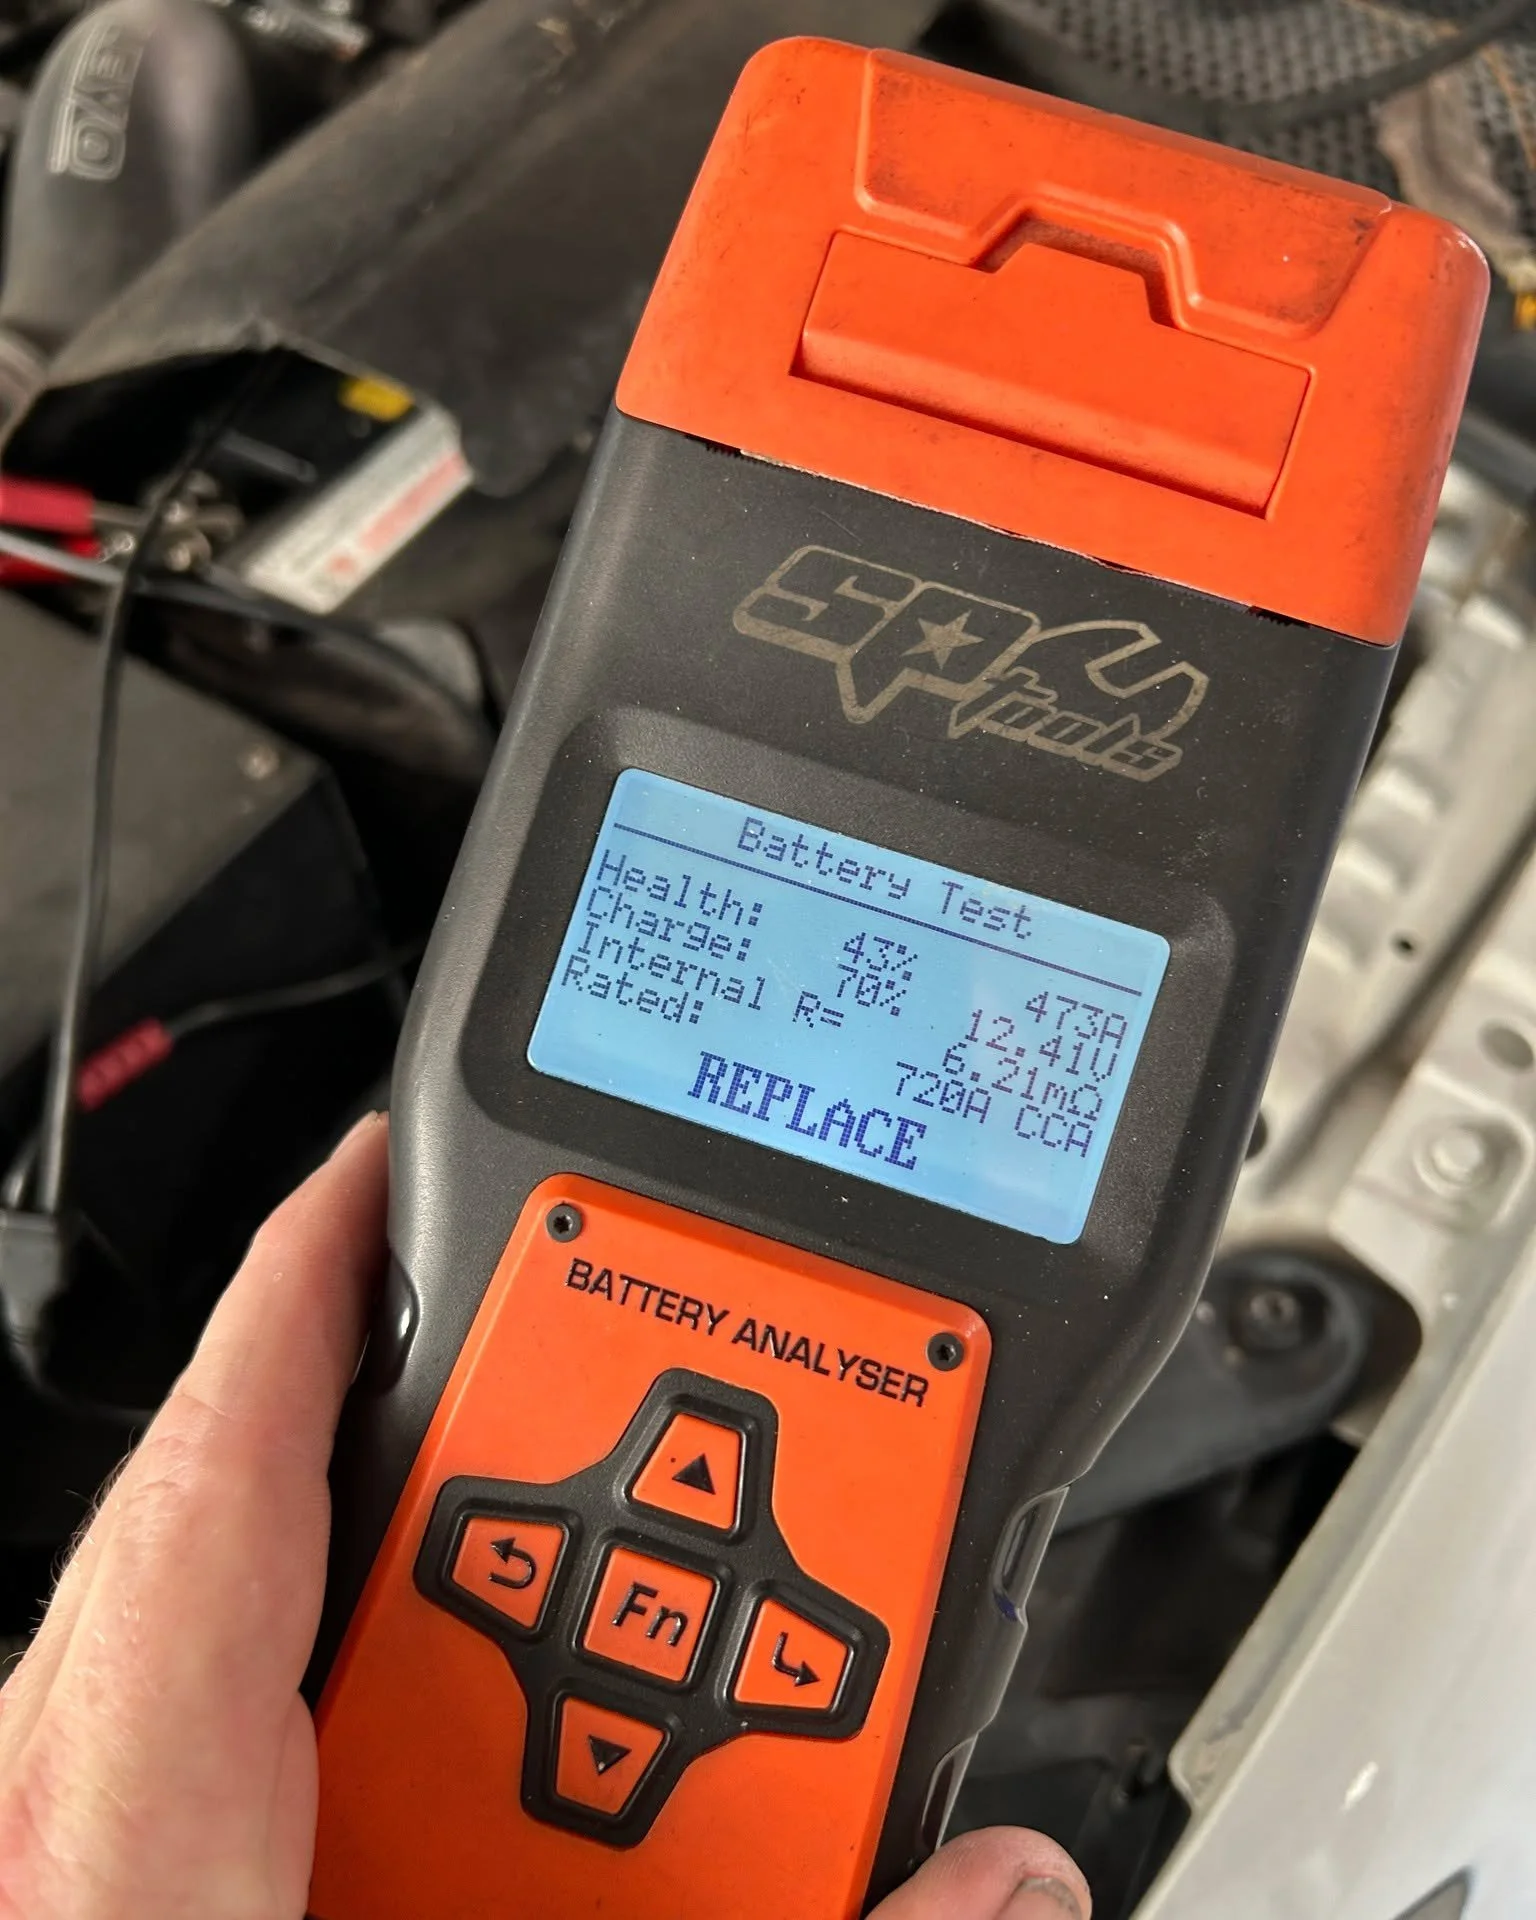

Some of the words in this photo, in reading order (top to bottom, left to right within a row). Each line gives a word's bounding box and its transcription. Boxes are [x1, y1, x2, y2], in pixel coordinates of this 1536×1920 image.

[596, 848, 764, 927] Health:
[842, 931, 919, 982] 43%
[1024, 990, 1129, 1050] 473A
[736, 815, 911, 901] Battery
[941, 880, 1032, 940] Test
[560, 953, 704, 1025] Rated:
[896, 1060, 992, 1125] 720A
[1013, 1103, 1094, 1159] CCA
[576, 920, 766, 1011] Internal
[791, 990, 845, 1029] R=
[941, 1041, 1104, 1122] 6.21mΩ
[585, 885, 752, 962] Charge:
[836, 962, 907, 1017] 70%
[964, 1008, 1118, 1083] 12.41V
[687, 1050, 928, 1171] REPLACE
[565, 1257, 730, 1336] BATTERY
[731, 1317, 930, 1408] ANALYSER
[611, 1582, 690, 1647] Fn
